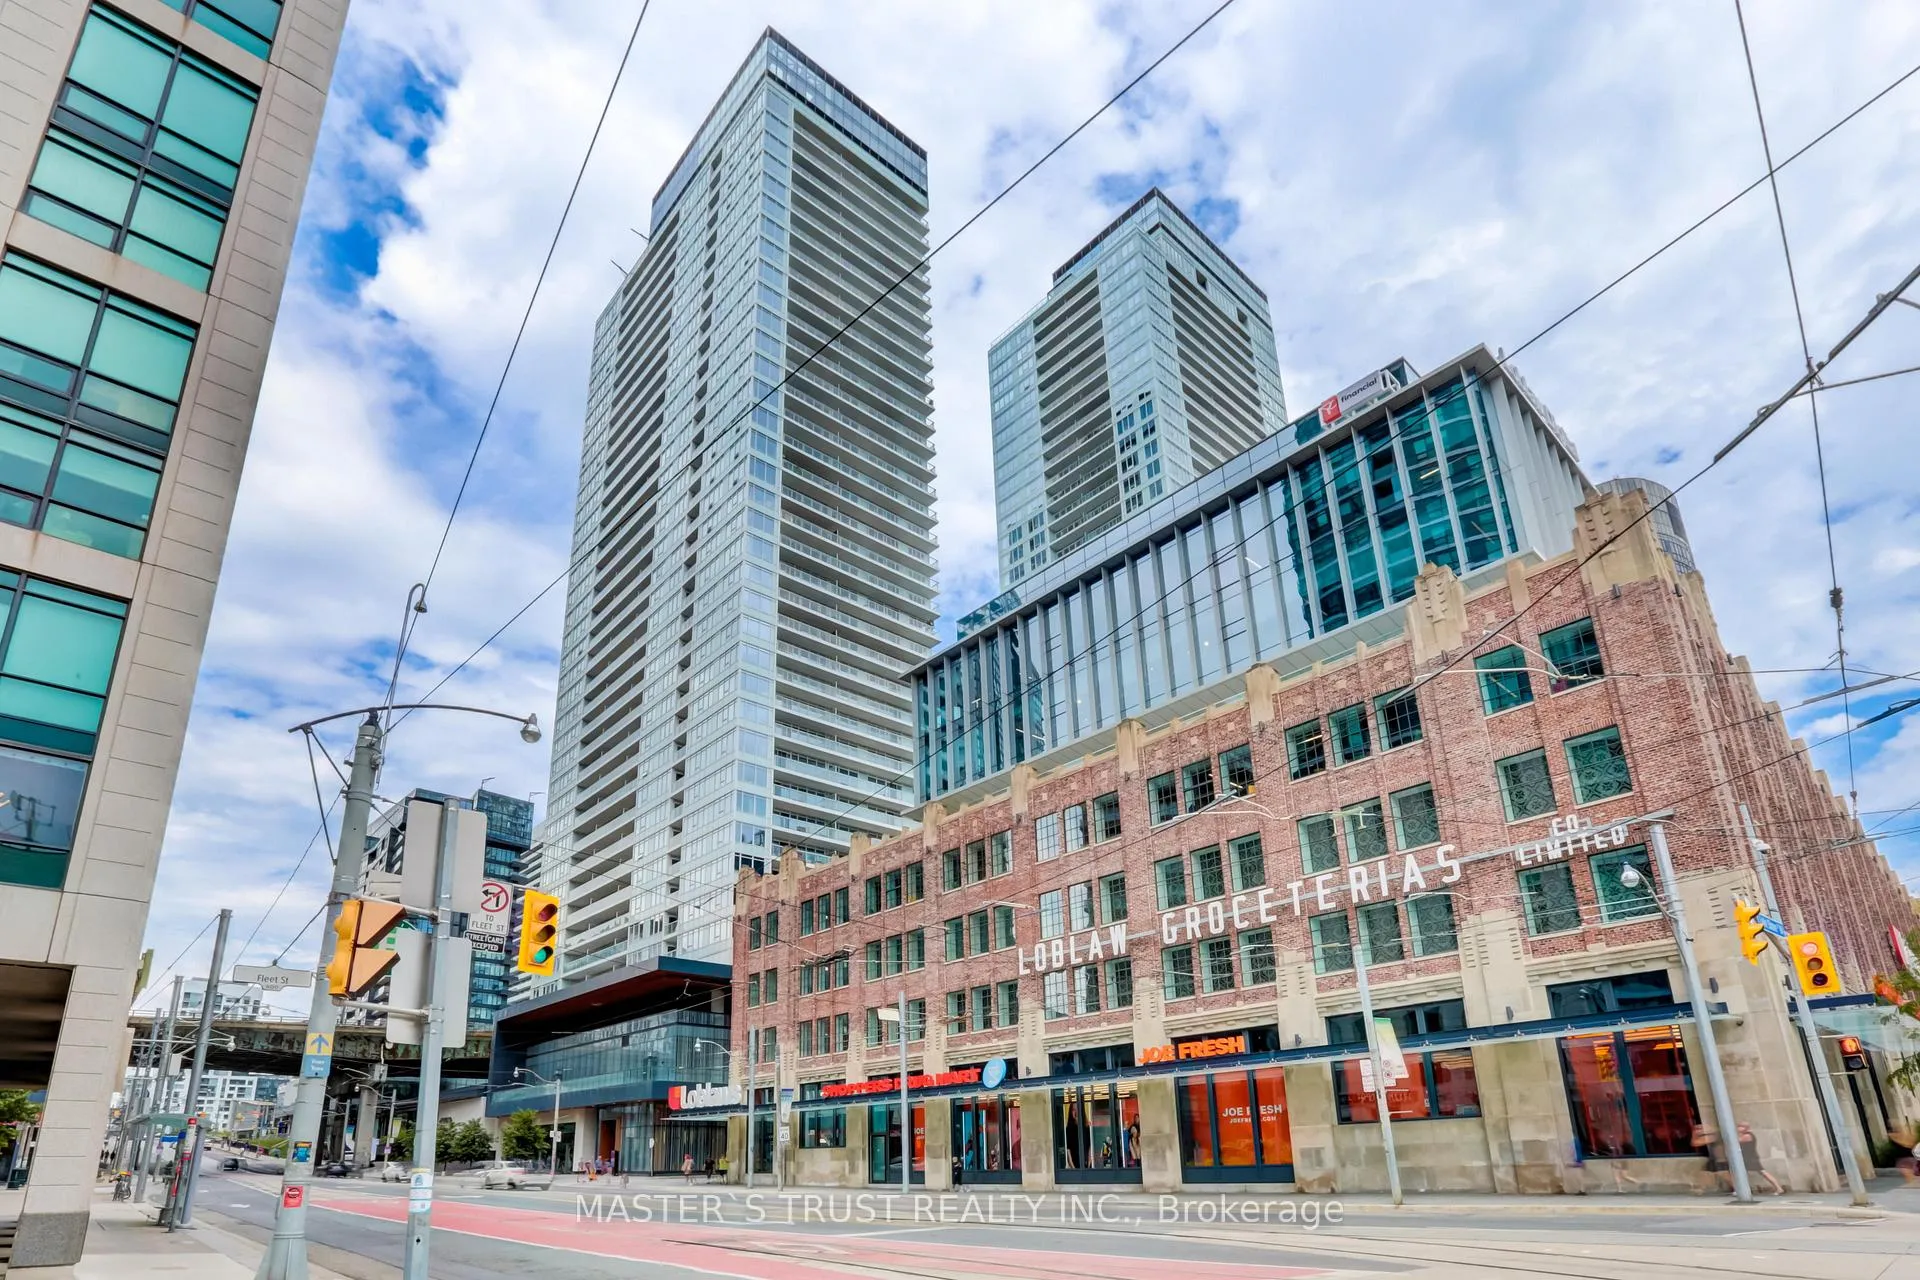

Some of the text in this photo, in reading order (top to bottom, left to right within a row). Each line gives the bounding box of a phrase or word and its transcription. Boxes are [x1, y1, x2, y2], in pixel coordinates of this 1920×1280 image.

[1341, 377, 1378, 402] financial
[1518, 823, 1628, 867] LIMITED
[1018, 844, 1462, 976] LOBLAW GROCETERIAS
[486, 914, 494, 922] TO
[471, 920, 504, 932] FLEET ST
[466, 932, 504, 944] STREETCARS
[470, 941, 499, 951] XCEPTED
[257, 974, 289, 985] Fleet St
[1138, 1035, 1246, 1065] JOE FRESH
[820, 1078, 894, 1098] SHOPPERS
[935, 1067, 981, 1085] MART
[1222, 1104, 1283, 1118] JOE FESH
